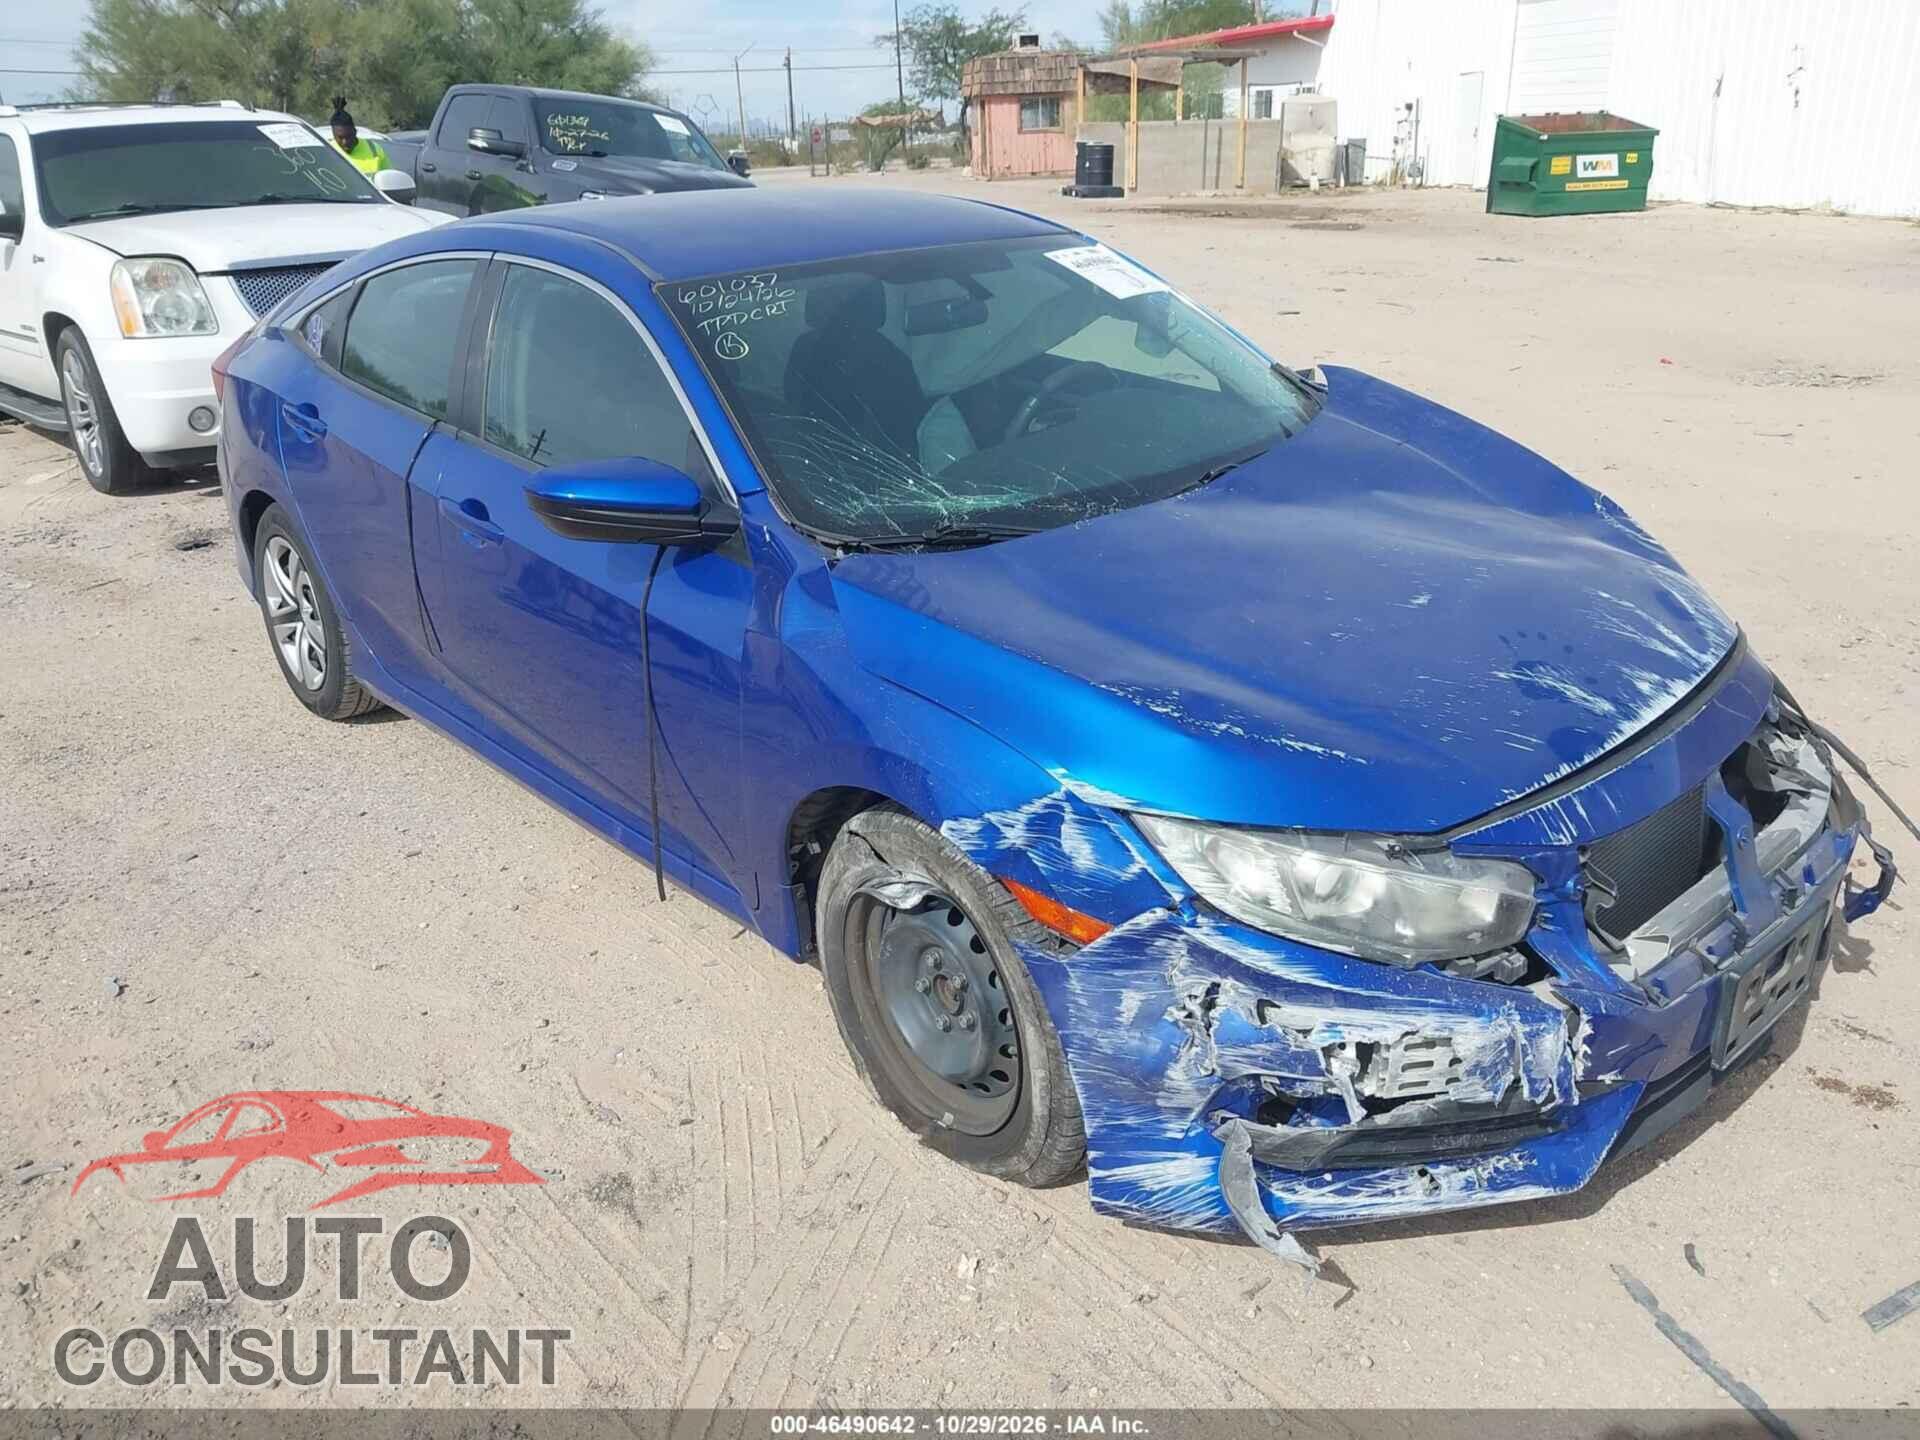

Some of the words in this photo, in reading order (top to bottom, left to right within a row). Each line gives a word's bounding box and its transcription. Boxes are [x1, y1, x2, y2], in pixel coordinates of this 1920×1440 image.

[1583, 159, 1614, 172] WM
[678, 272, 778, 304] 601037
[691, 287, 796, 316] 10/24/26
